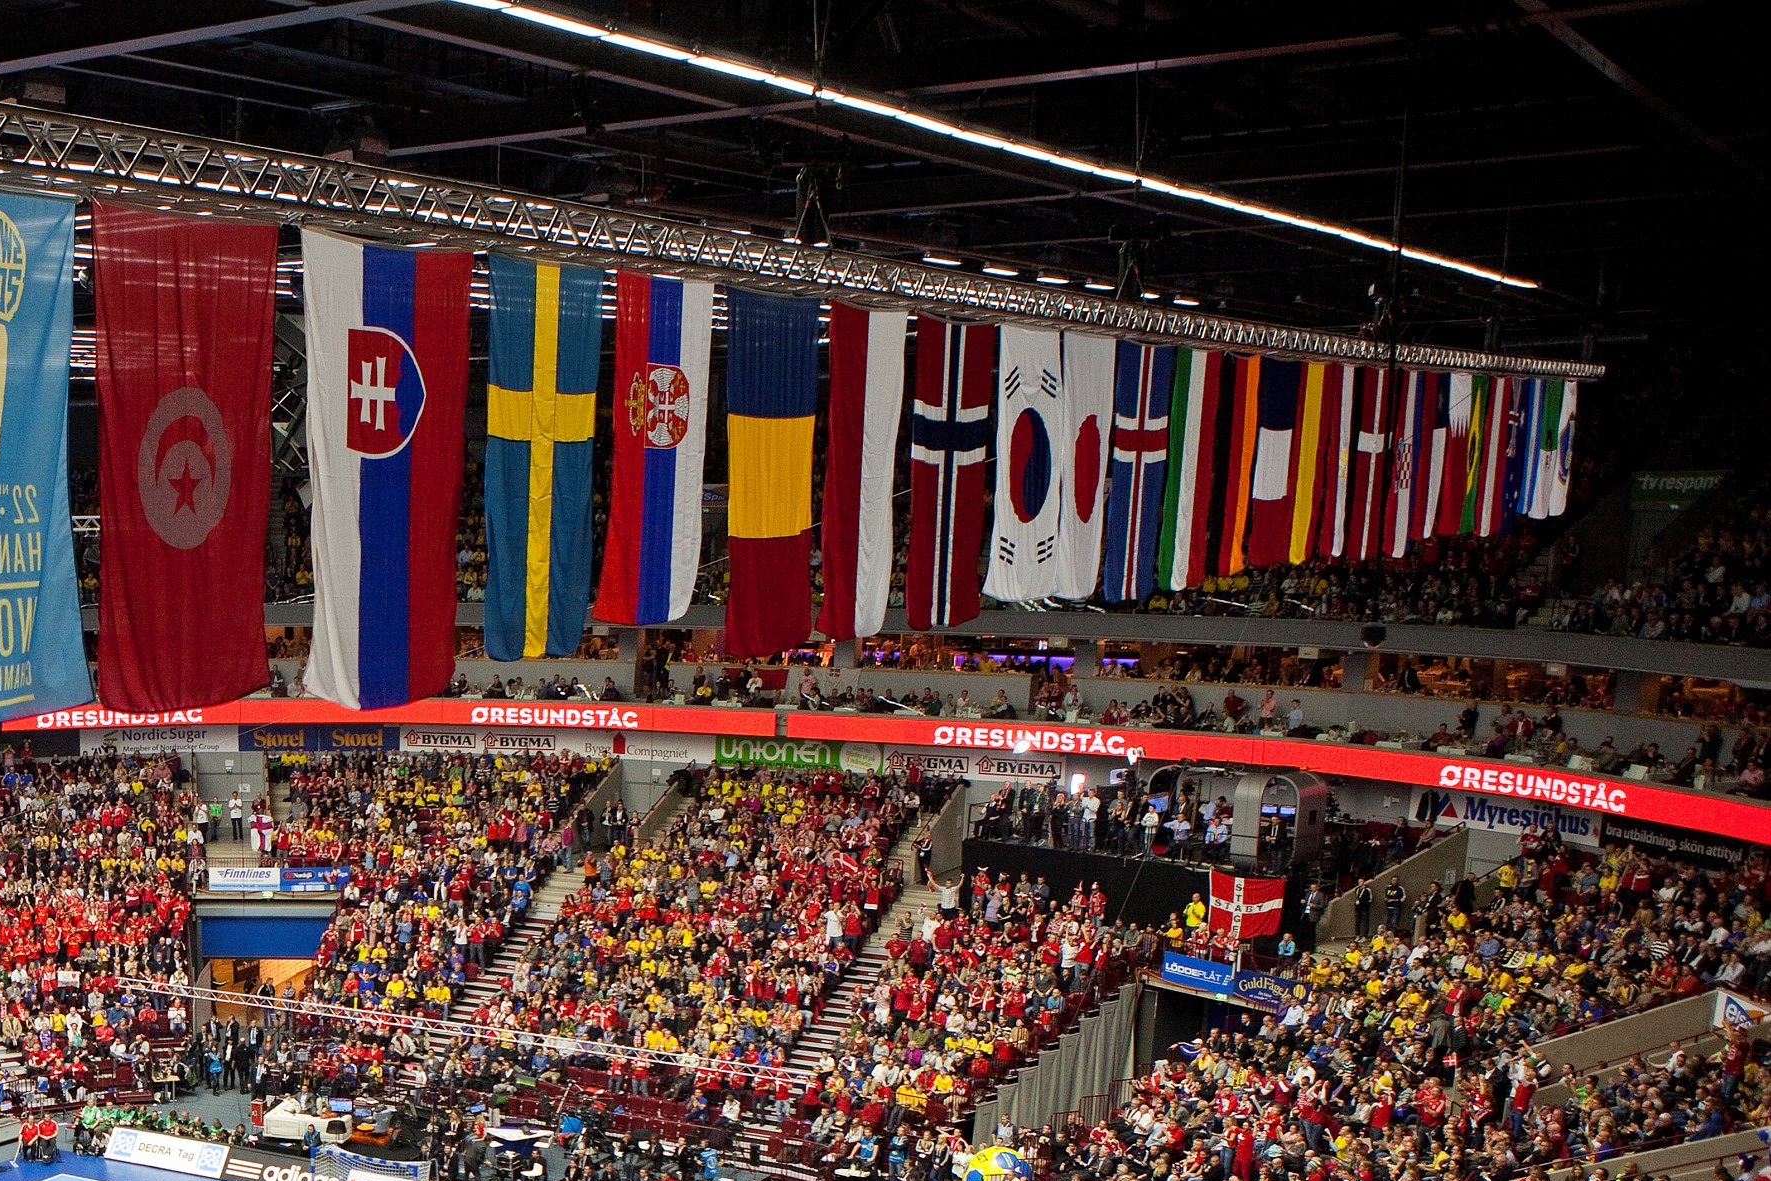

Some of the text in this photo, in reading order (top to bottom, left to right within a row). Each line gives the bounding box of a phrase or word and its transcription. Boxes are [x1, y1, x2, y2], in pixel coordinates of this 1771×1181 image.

[471, 707, 638, 729] ØRESUNDSTÅG
[122, 727, 207, 743] Nordic Sugar
[253, 730, 305, 749] Storel
[331, 729, 384, 748] Storel
[421, 733, 473, 746] BYGMA
[499, 736, 552, 749] BYGMA
[933, 726, 1126, 755] ØRESUNDSTÅG
[627, 744, 689, 760] Compagniet
[996, 761, 1058, 778] BYGMA
[1439, 764, 1627, 813] ØRESUNDSTÅG
[1462, 796, 1590, 837] Myresjöhus
[1605, 822, 1623, 838] bra
[1679, 839, 1704, 854] skön
[223, 868, 272, 879] Finnlines
[1165, 962, 1222, 982] LÖDDEPLÅT
[138, 1142, 194, 1162] DECRA Tag
